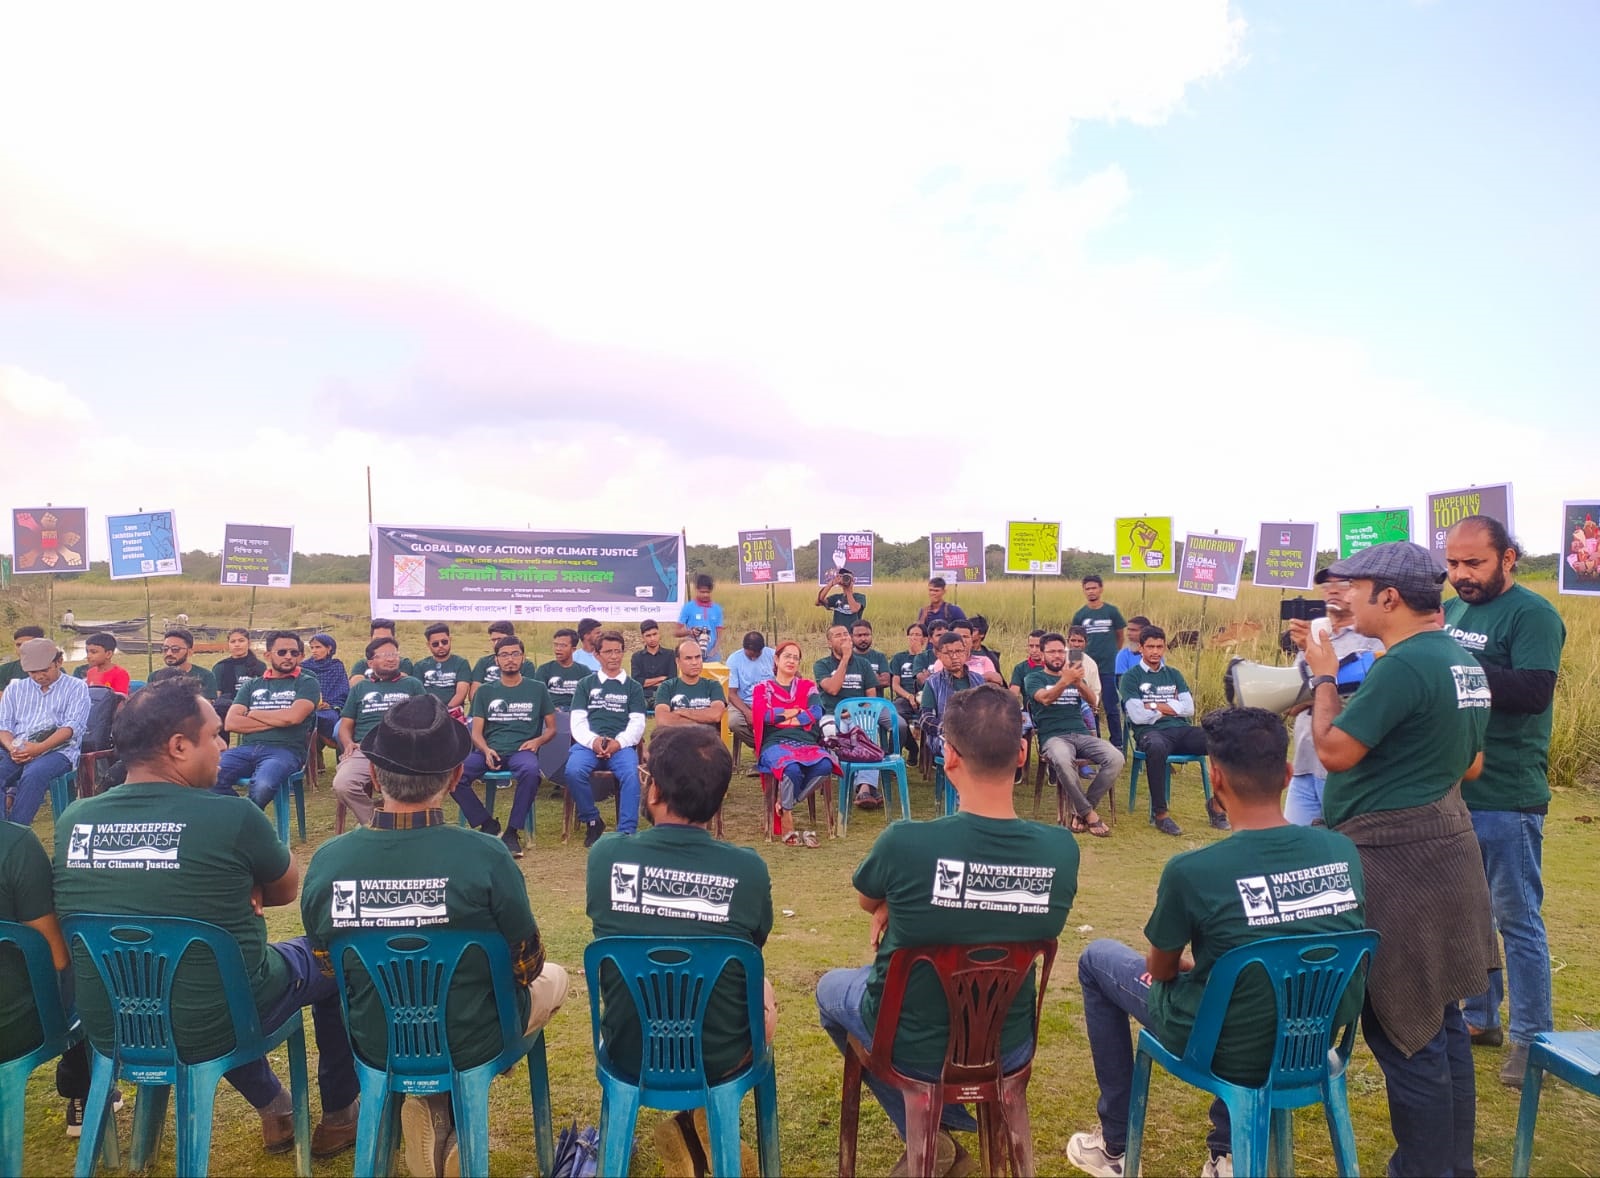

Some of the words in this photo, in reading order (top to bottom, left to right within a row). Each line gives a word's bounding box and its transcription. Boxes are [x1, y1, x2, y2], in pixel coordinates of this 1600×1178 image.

[1434, 493, 1480, 510] HAPPENING
[1434, 504, 1480, 528] TODAY
[837, 535, 871, 543] GLOBAL
[934, 542, 968, 550] GLOBAL
[1189, 537, 1237, 553] TOMORROW
[410, 543, 453, 553] GLOBAL
[454, 544, 477, 554] DAY
[478, 546, 492, 554] OF
[494, 546, 532, 555] ACTION
[534, 547, 555, 555] FOR
[556, 548, 598, 556] CLIMATE
[599, 549, 639, 557] JUSTICE
[742, 541, 753, 563] 3
[753, 539, 773, 551] DAYS
[754, 550, 763, 561] TO
[765, 550, 775, 561] GO
[746, 560, 771, 569] GLOBAL
[1187, 556, 1216, 566] GLOBAL
[499, 565, 558, 583] নাগরিক
[561, 569, 615, 583] সমাবেশ
[93, 834, 180, 847] BANGLADESH
[93, 861, 106, 869] for
[108, 861, 144, 869] Climate
[146, 861, 180, 870] Justice
[641, 877, 733, 902] BANGLADESH
[966, 874, 1053, 891] BANGLADESH
[1273, 874, 1352, 899] BANGLADESH
[360, 889, 446, 904] BANGLADESH
[611, 902, 640, 913] Action
[641, 905, 656, 915] for
[657, 907, 696, 919] Climate
[697, 911, 730, 923] Justice
[930, 897, 962, 908] Action
[964, 899, 978, 909] for
[980, 901, 1018, 912] Climate
[1018, 903, 1049, 914] Justice
[332, 918, 360, 927] Action
[361, 919, 375, 927] for
[376, 918, 415, 927] Climate
[416, 916, 449, 928] Justice
[1248, 914, 1280, 926] Action
[1281, 912, 1295, 922] for
[1296, 906, 1333, 920] Climate
